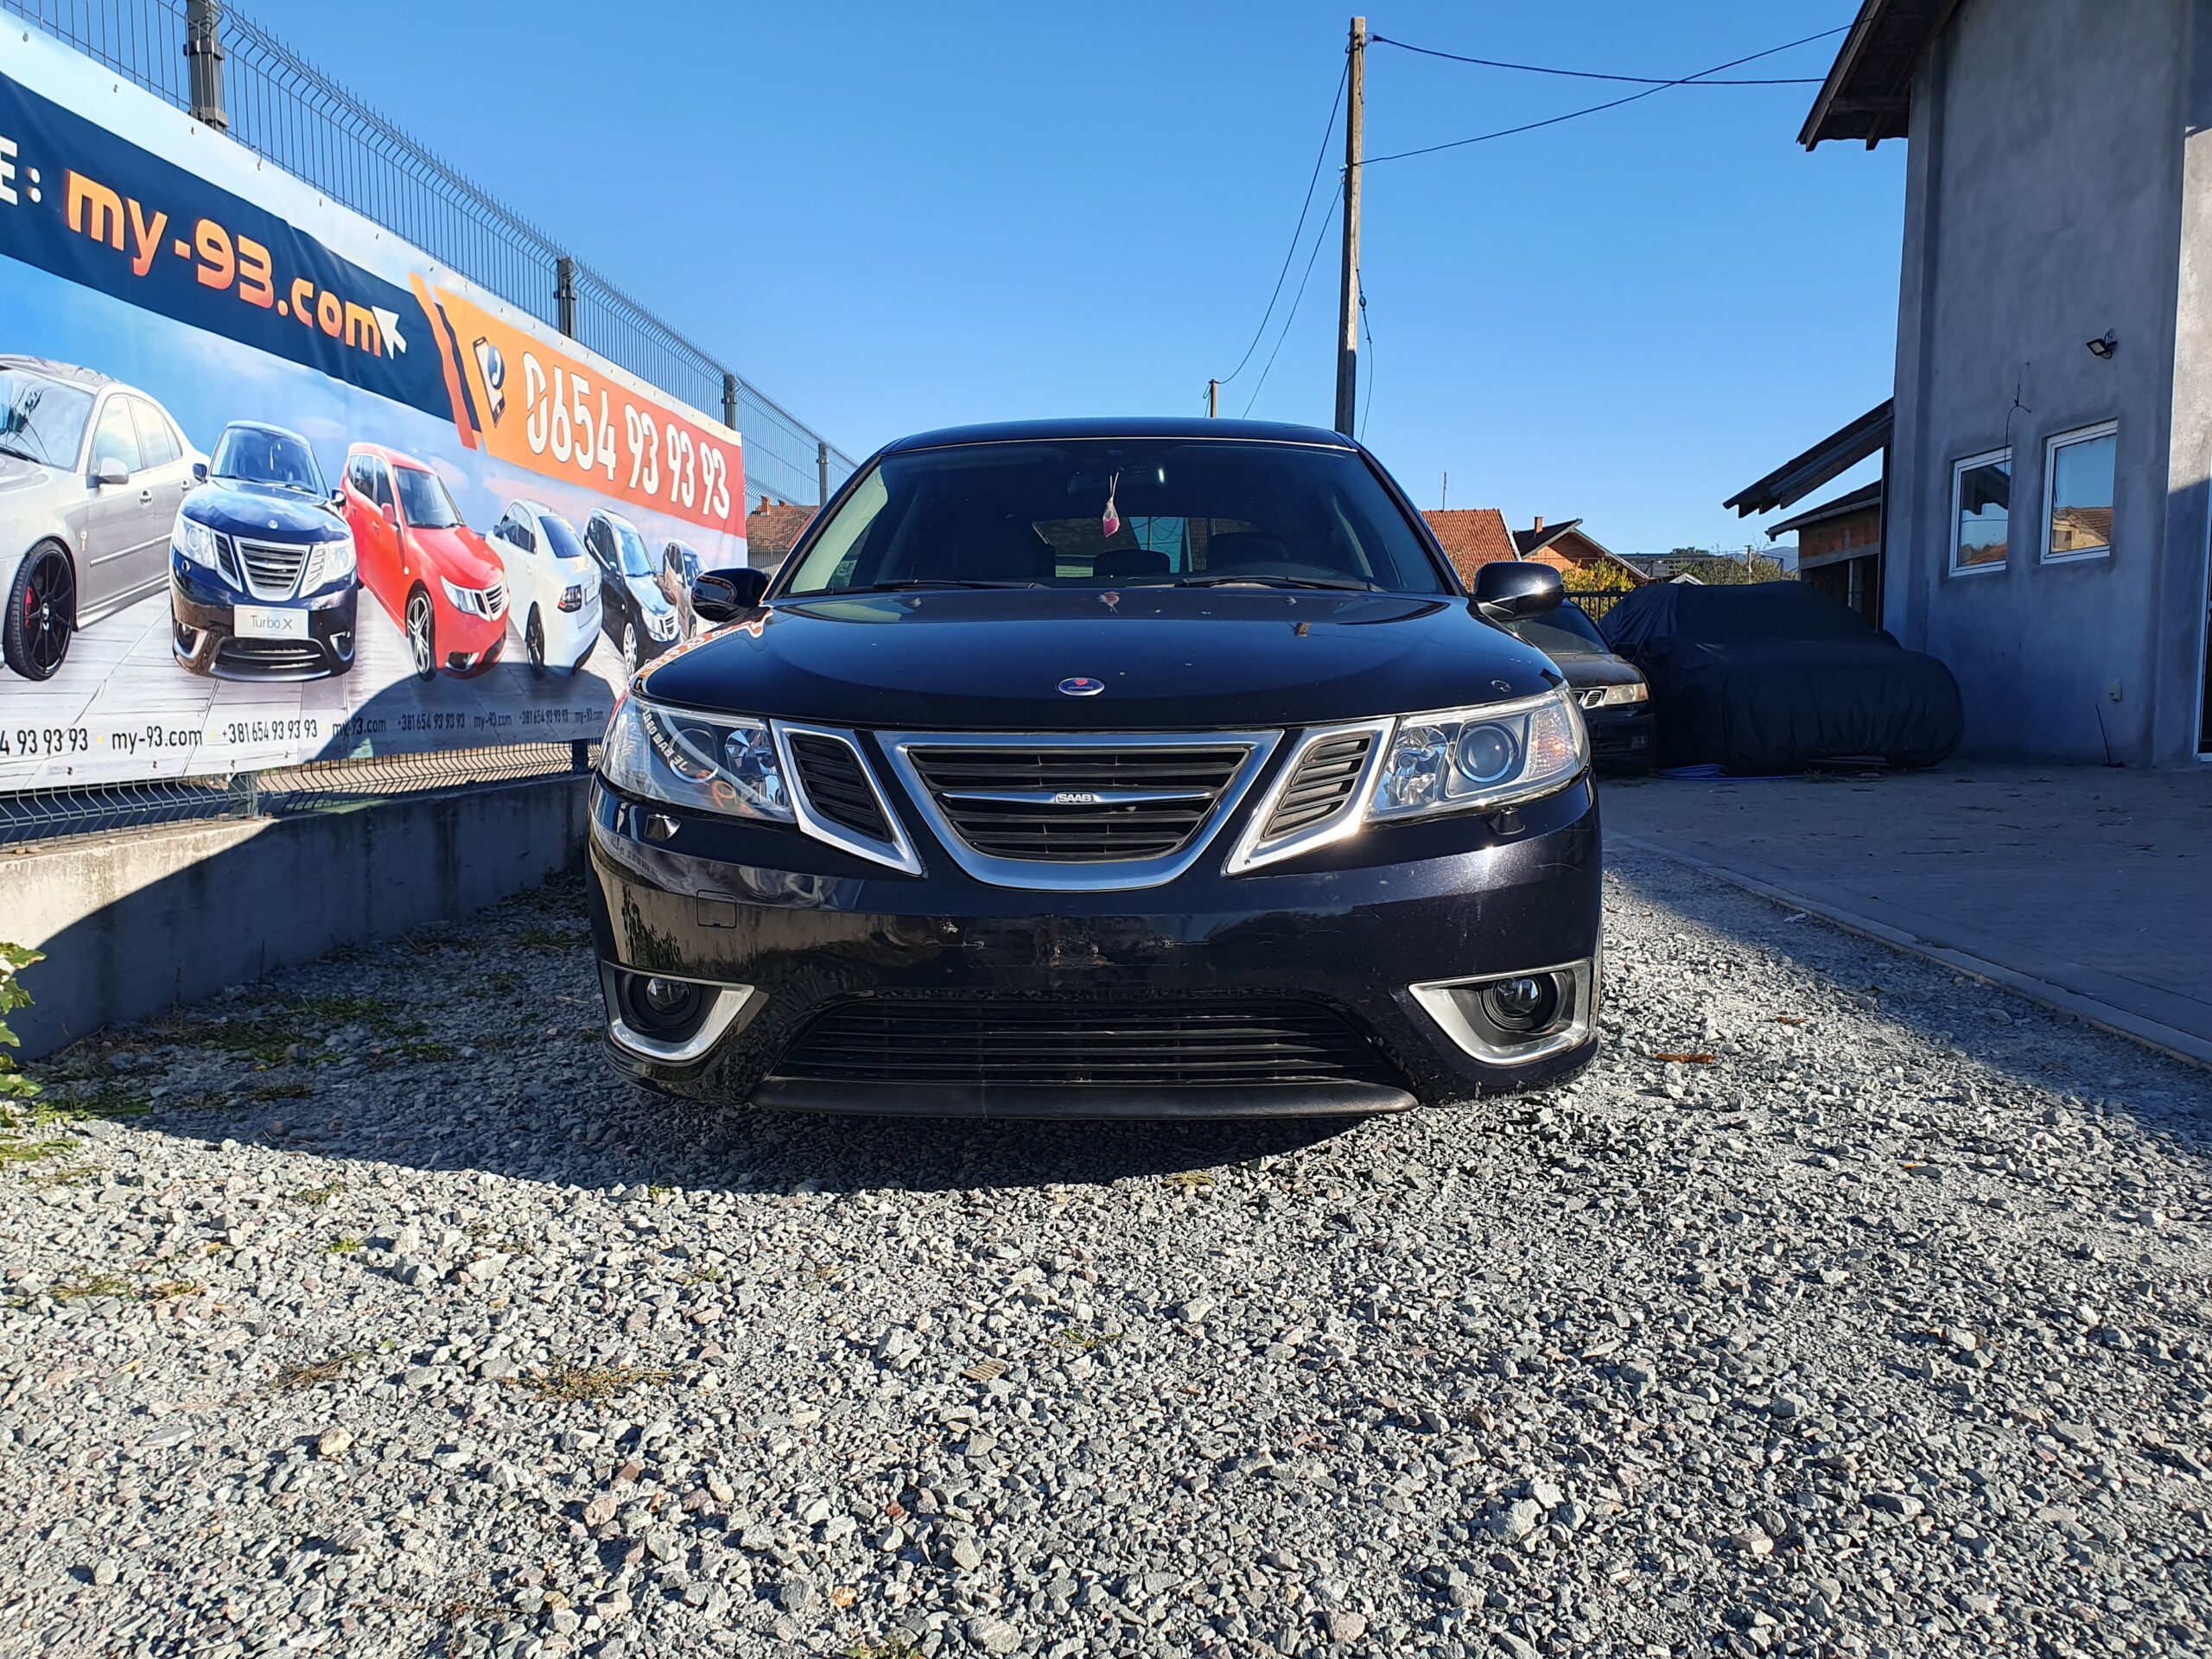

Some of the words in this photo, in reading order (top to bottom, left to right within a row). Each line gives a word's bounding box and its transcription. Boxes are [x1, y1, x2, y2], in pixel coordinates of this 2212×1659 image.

[66, 168, 382, 358] my-93.com
[522, 352, 617, 481] 0654
[625, 403, 659, 495] 93
[666, 423, 695, 509] 93
[700, 441, 730, 519] 93
[251, 614, 281, 630] Turbo
[283, 618, 293, 630] X
[17, 729, 37, 755] 93
[43, 728, 63, 754] 93
[69, 728, 88, 753] 93
[111, 725, 203, 755] my-93.com
[271, 720, 284, 741] 93
[287, 719, 300, 739] 93
[303, 718, 317, 738] 93
[332, 716, 386, 741] my-93.com
[434, 712, 443, 730] 93
[445, 711, 454, 729] 93
[456, 711, 465, 729] 93
[474, 711, 512, 731] my-93.com
[1058, 793, 1093, 803] SAAB
